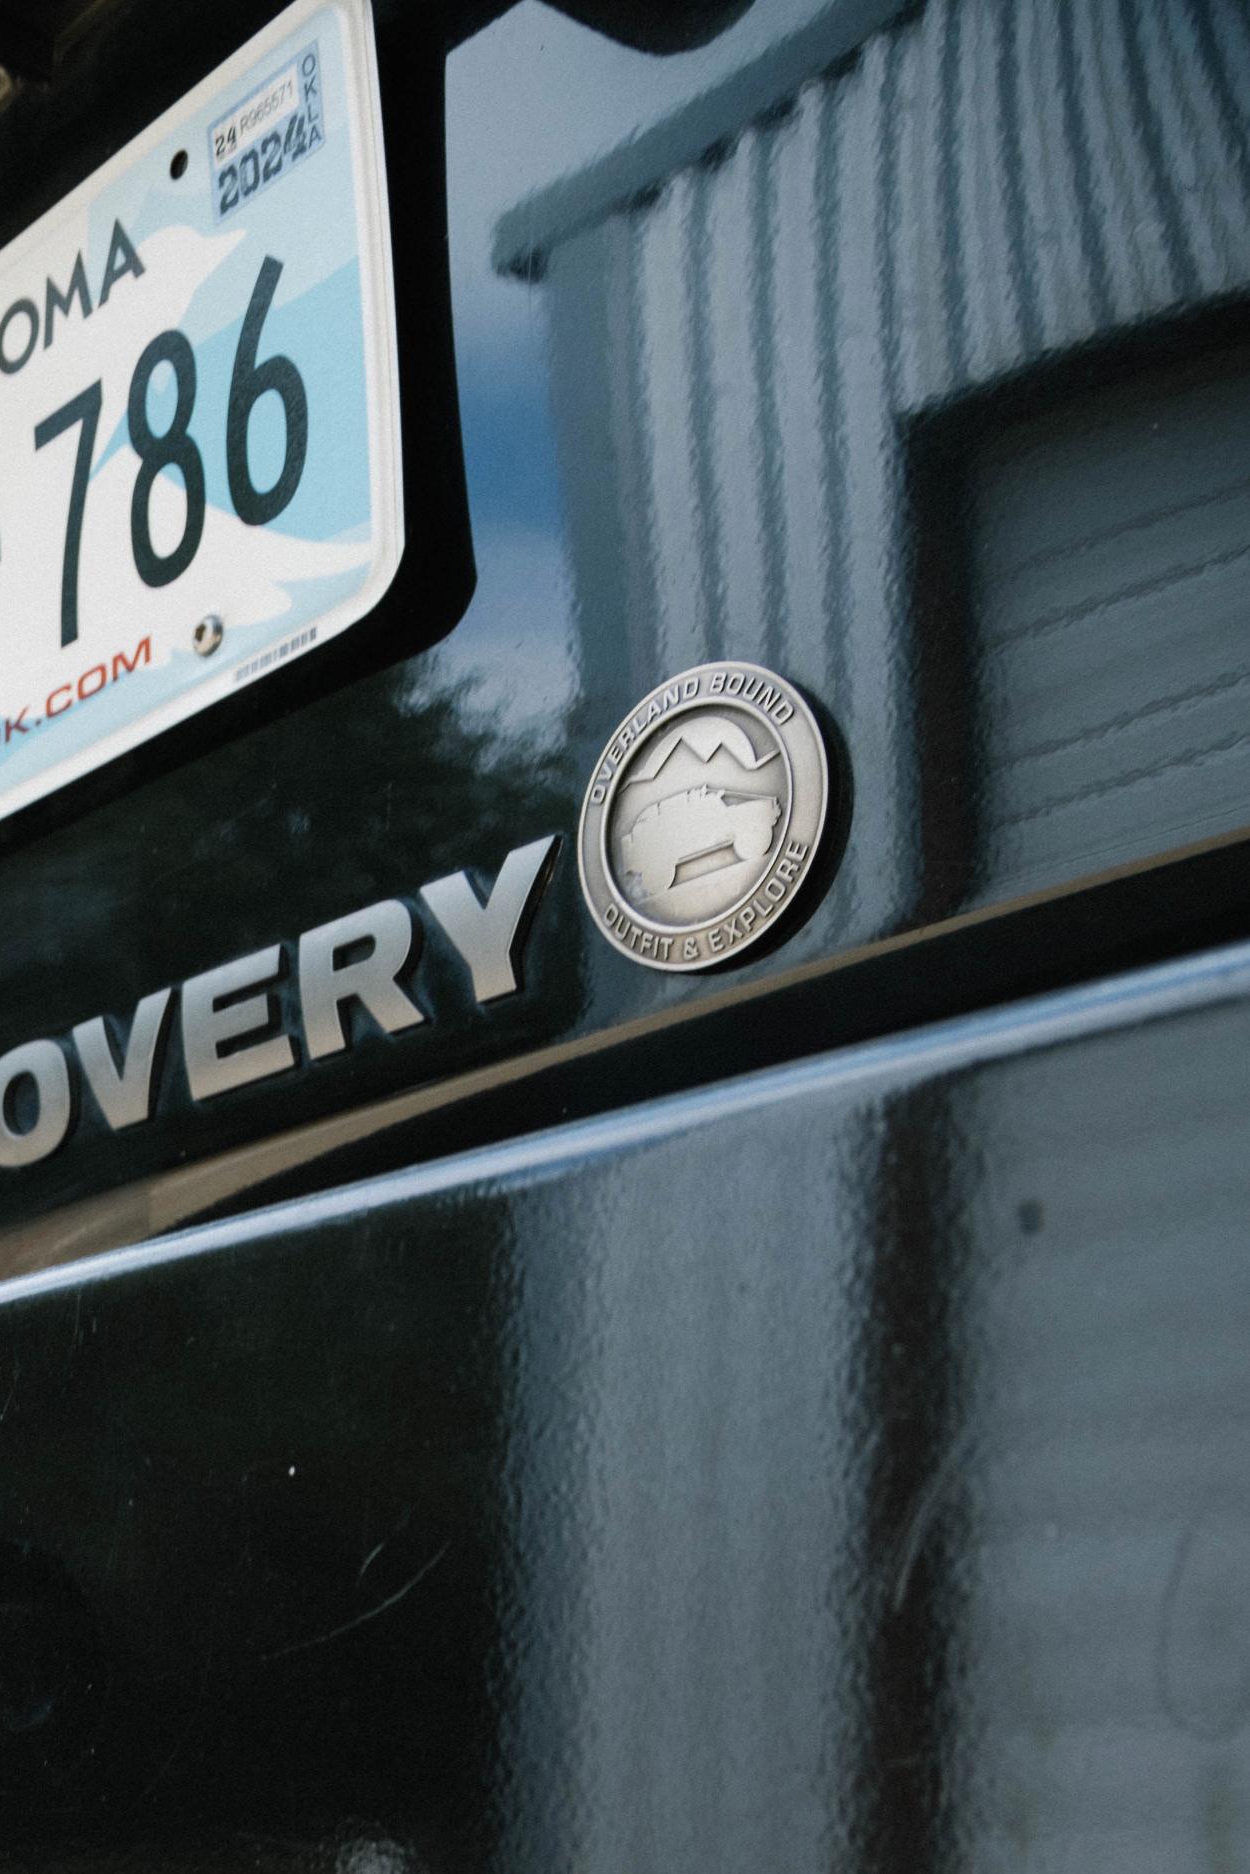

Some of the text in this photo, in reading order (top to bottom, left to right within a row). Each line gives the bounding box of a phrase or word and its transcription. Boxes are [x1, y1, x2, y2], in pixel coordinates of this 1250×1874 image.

[302, 53, 321, 148] OKLA
[218, 111, 307, 216] 2024
[34, 255, 308, 650] 786
[590, 672, 794, 805] OVERLAND BOUND
[603, 839, 810, 962] OUTFIT & EXPLORE
